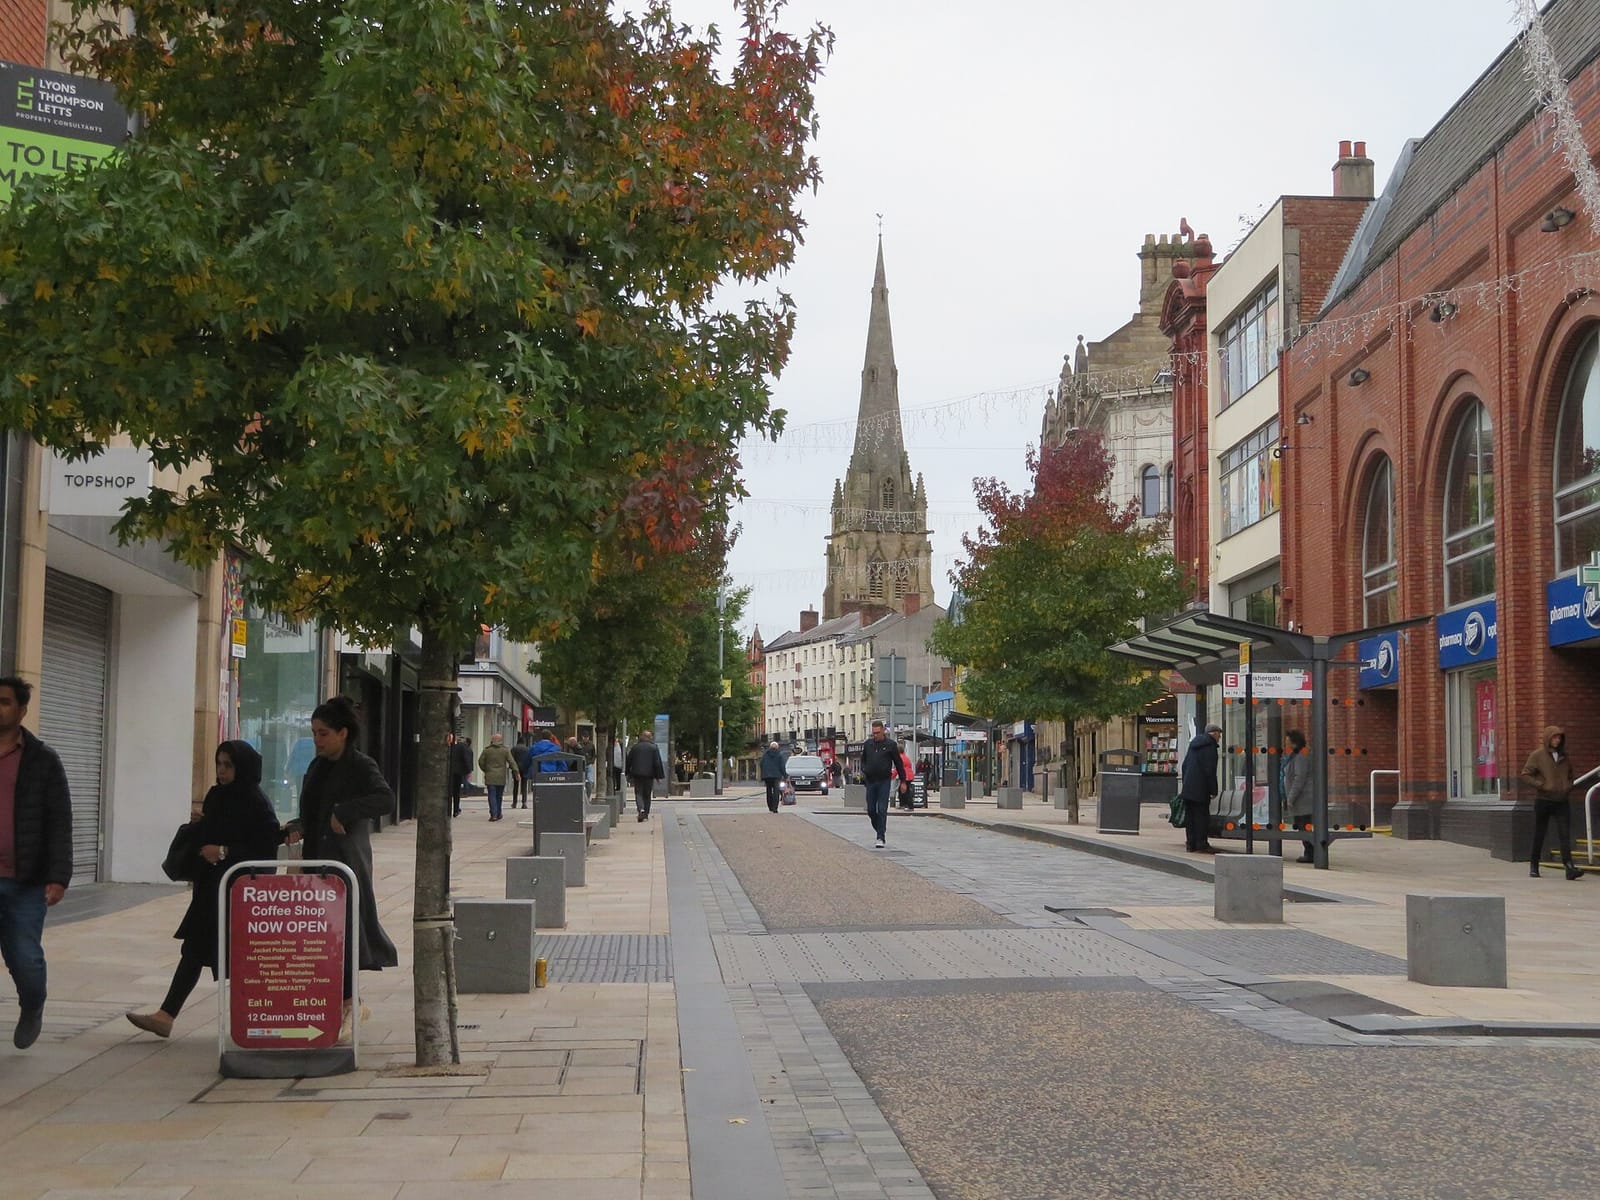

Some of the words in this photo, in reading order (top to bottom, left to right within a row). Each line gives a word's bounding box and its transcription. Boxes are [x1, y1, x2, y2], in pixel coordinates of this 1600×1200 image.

[39, 79, 77, 95] LYONS
[38, 90, 105, 112] THOMPSON
[37, 102, 73, 118] LETTS
[15, 112, 52, 124] PROPERTY
[53, 119, 104, 133] CONSULTANTS
[7, 141, 46, 167] TO
[52, 149, 98, 174] LET
[64, 474, 136, 489] TOPSHOP
[1550, 602, 1581, 625] pharmacy
[1439, 632, 1463, 651] pharmacy
[1226, 675, 1237, 687] E
[243, 886, 337, 902] Ravenous
[251, 905, 291, 916] Coffee
[294, 905, 326, 918] Shop
[247, 921, 283, 933] NOW
[286, 920, 328, 933] OPEN
[247, 999, 263, 1007] Eat
[264, 998, 273, 1007] In
[293, 998, 308, 1007] Eat
[310, 997, 327, 1007] Out
[247, 1013, 258, 1021] 12
[259, 1013, 295, 1021] Cannon
[296, 1012, 325, 1021] Street
